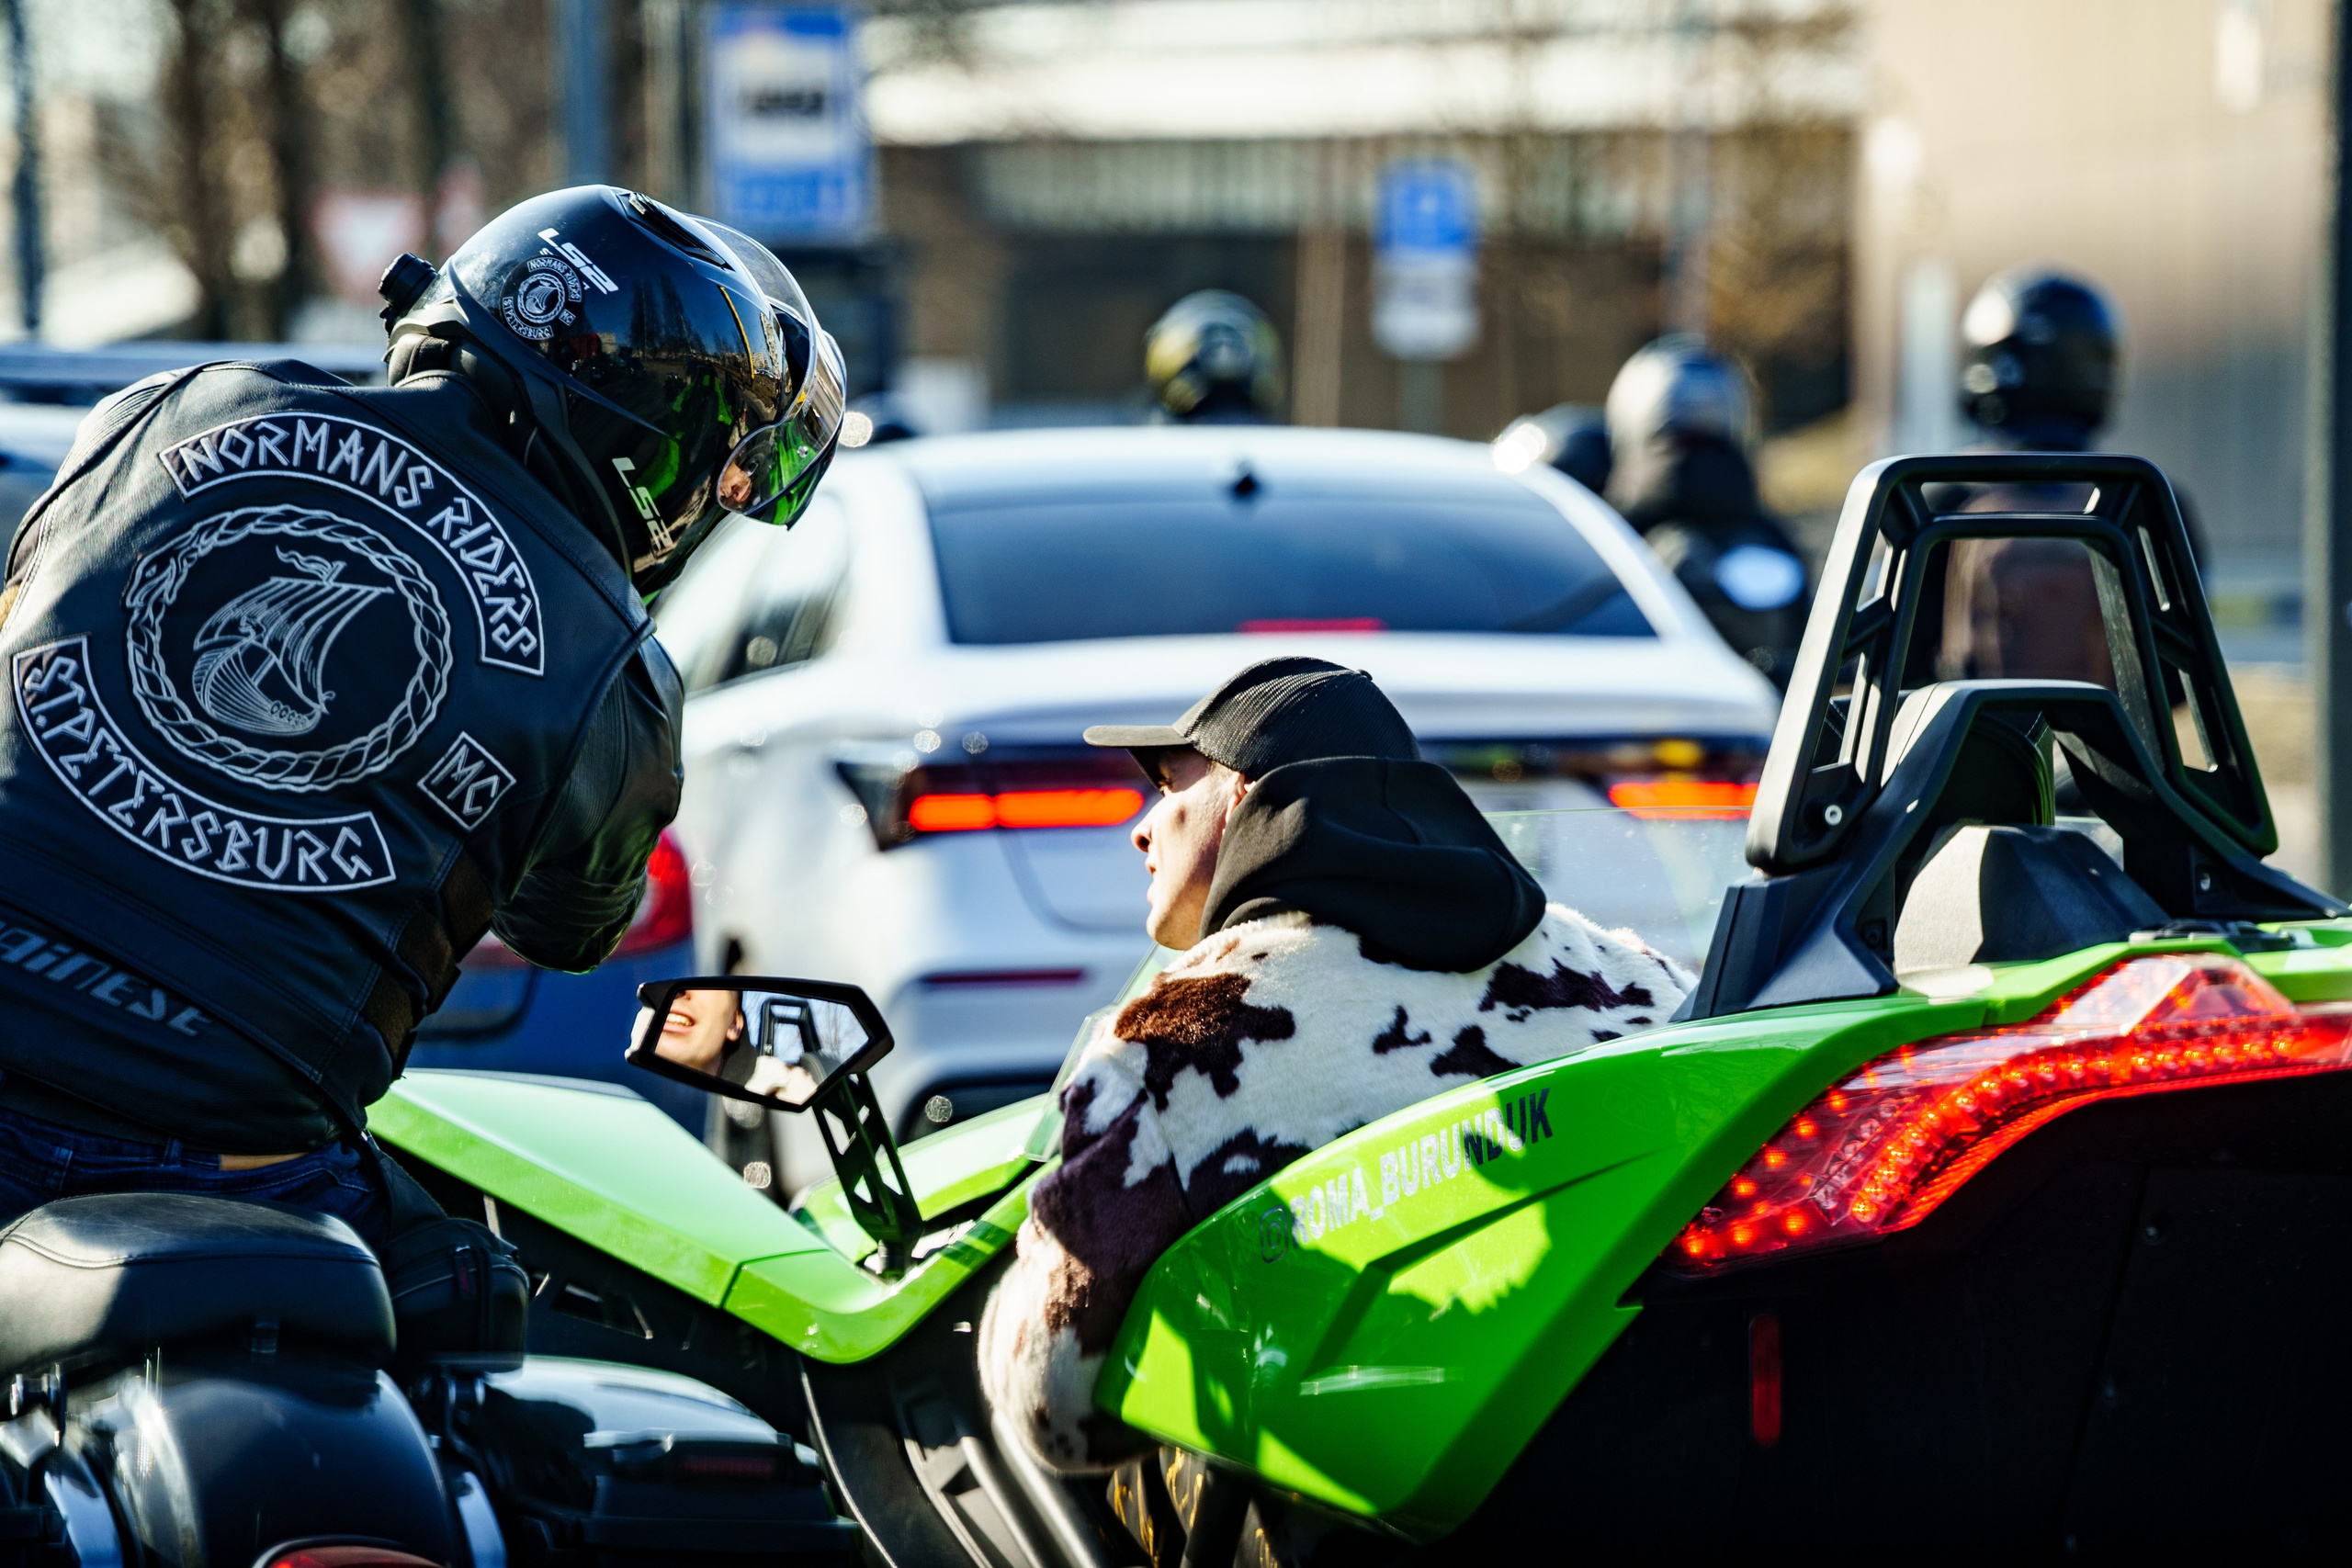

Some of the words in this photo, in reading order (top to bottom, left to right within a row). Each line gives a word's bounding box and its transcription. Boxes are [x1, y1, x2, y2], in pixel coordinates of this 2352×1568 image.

[530, 258, 568, 273] NORMANS
[566, 269, 581, 300] RIDERS
[537, 228, 619, 295] LS2
[562, 310, 574, 324] MC
[182, 419, 432, 509] NORMANS
[427, 496, 538, 658] RIDERS
[612, 457, 673, 550] LS2
[445, 742, 500, 816] MC
